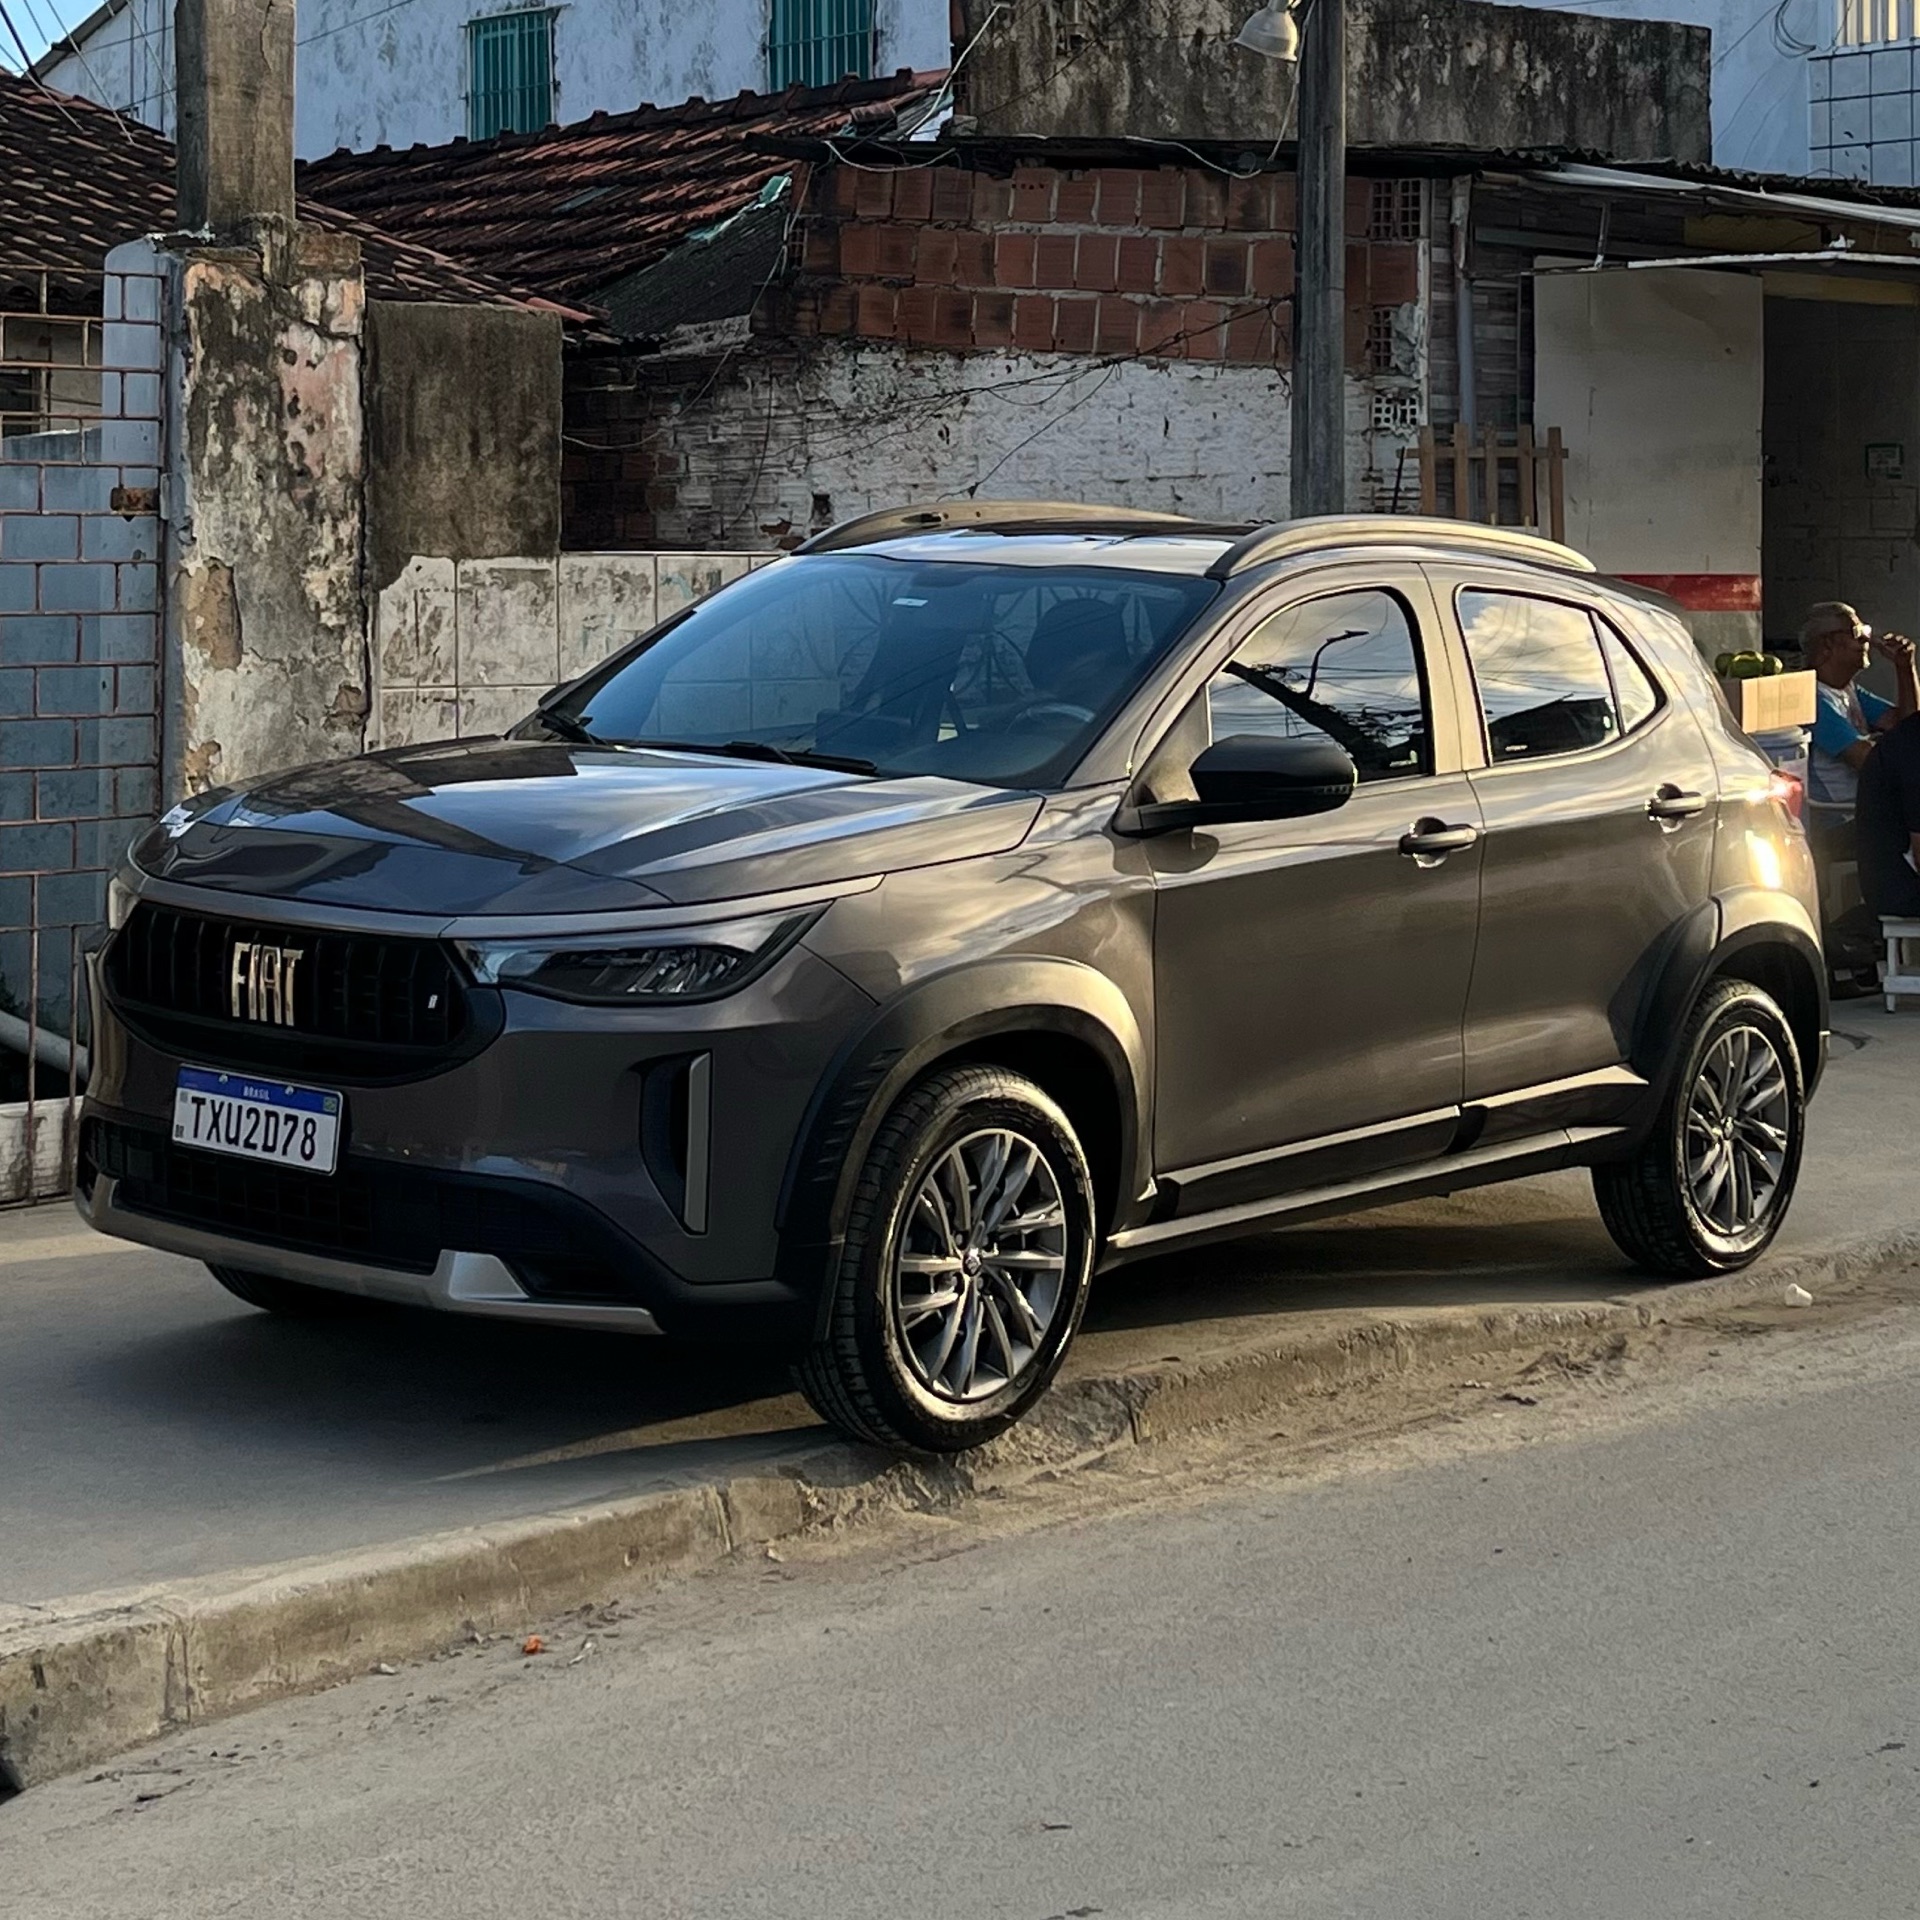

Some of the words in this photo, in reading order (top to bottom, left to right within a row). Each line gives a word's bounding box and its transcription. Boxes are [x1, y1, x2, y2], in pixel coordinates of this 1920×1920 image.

[231, 942, 304, 1027] FIAT
[242, 1085, 270, 1101] BRASIL
[191, 1096, 317, 1161] TXU2D78
